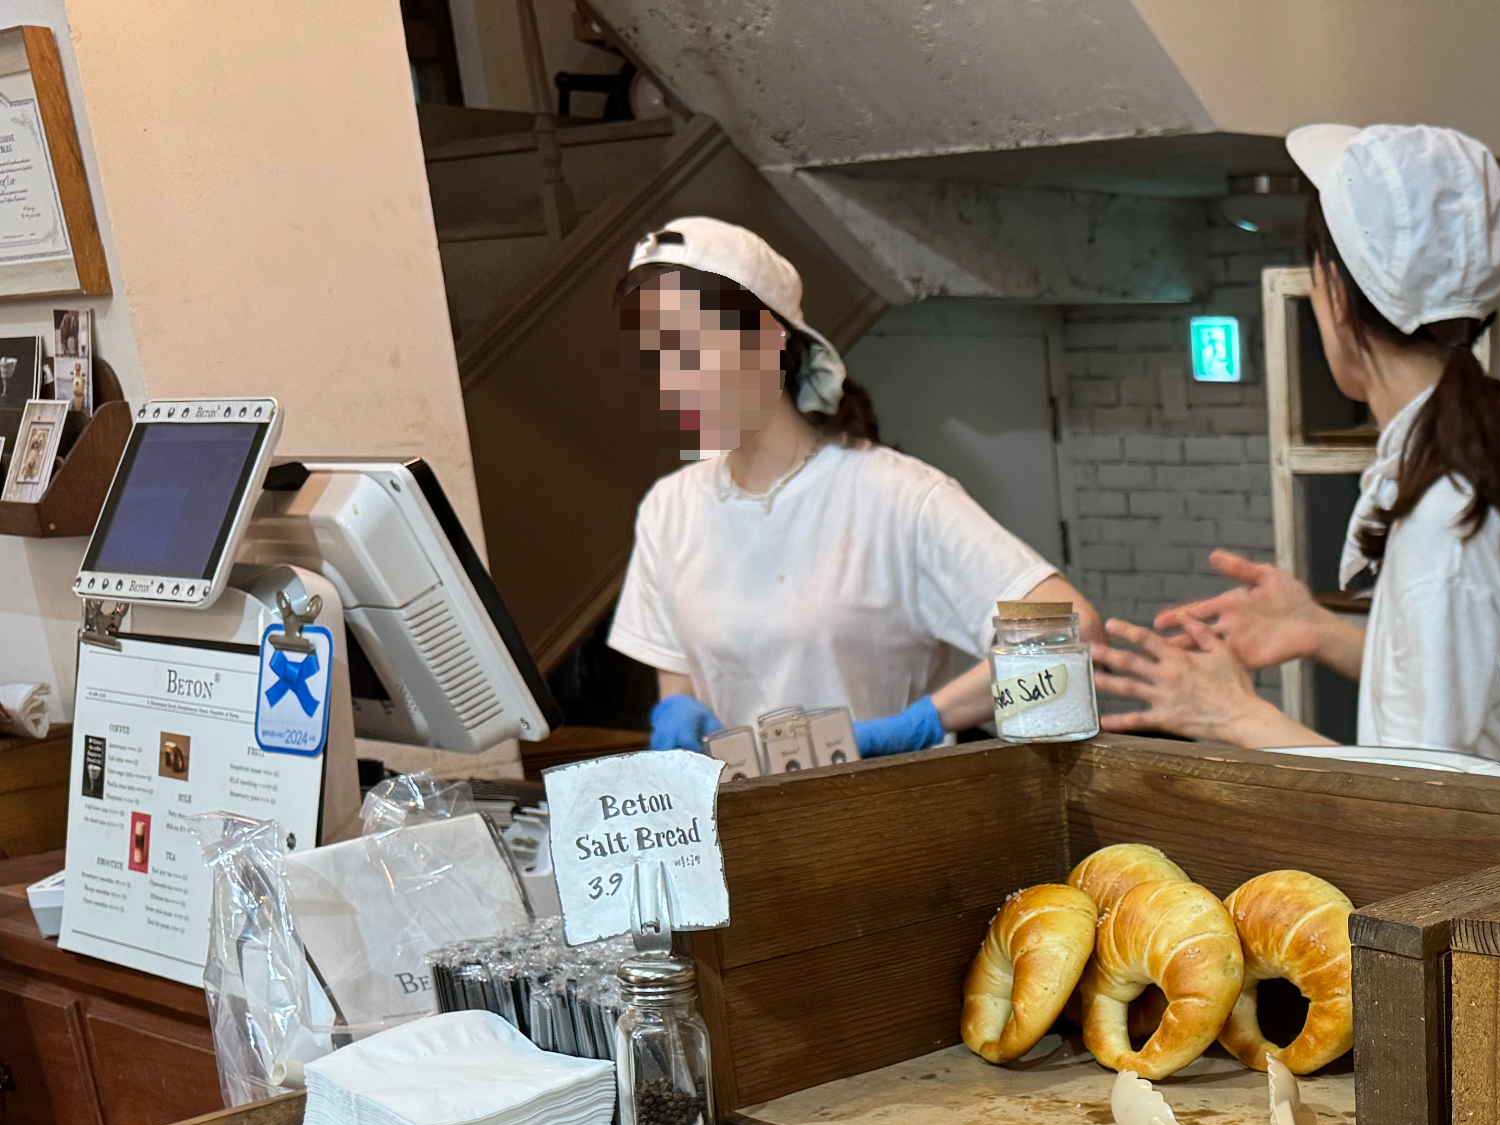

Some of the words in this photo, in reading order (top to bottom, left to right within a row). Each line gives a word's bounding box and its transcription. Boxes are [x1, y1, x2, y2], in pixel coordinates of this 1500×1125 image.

[1017, 669, 1057, 702] Salt
[284, 728, 308, 746] 2024
[598, 793, 674, 820] Beton
[575, 832, 630, 860] Salt
[634, 817, 702, 851] Bread
[588, 872, 623, 900] 3.9
